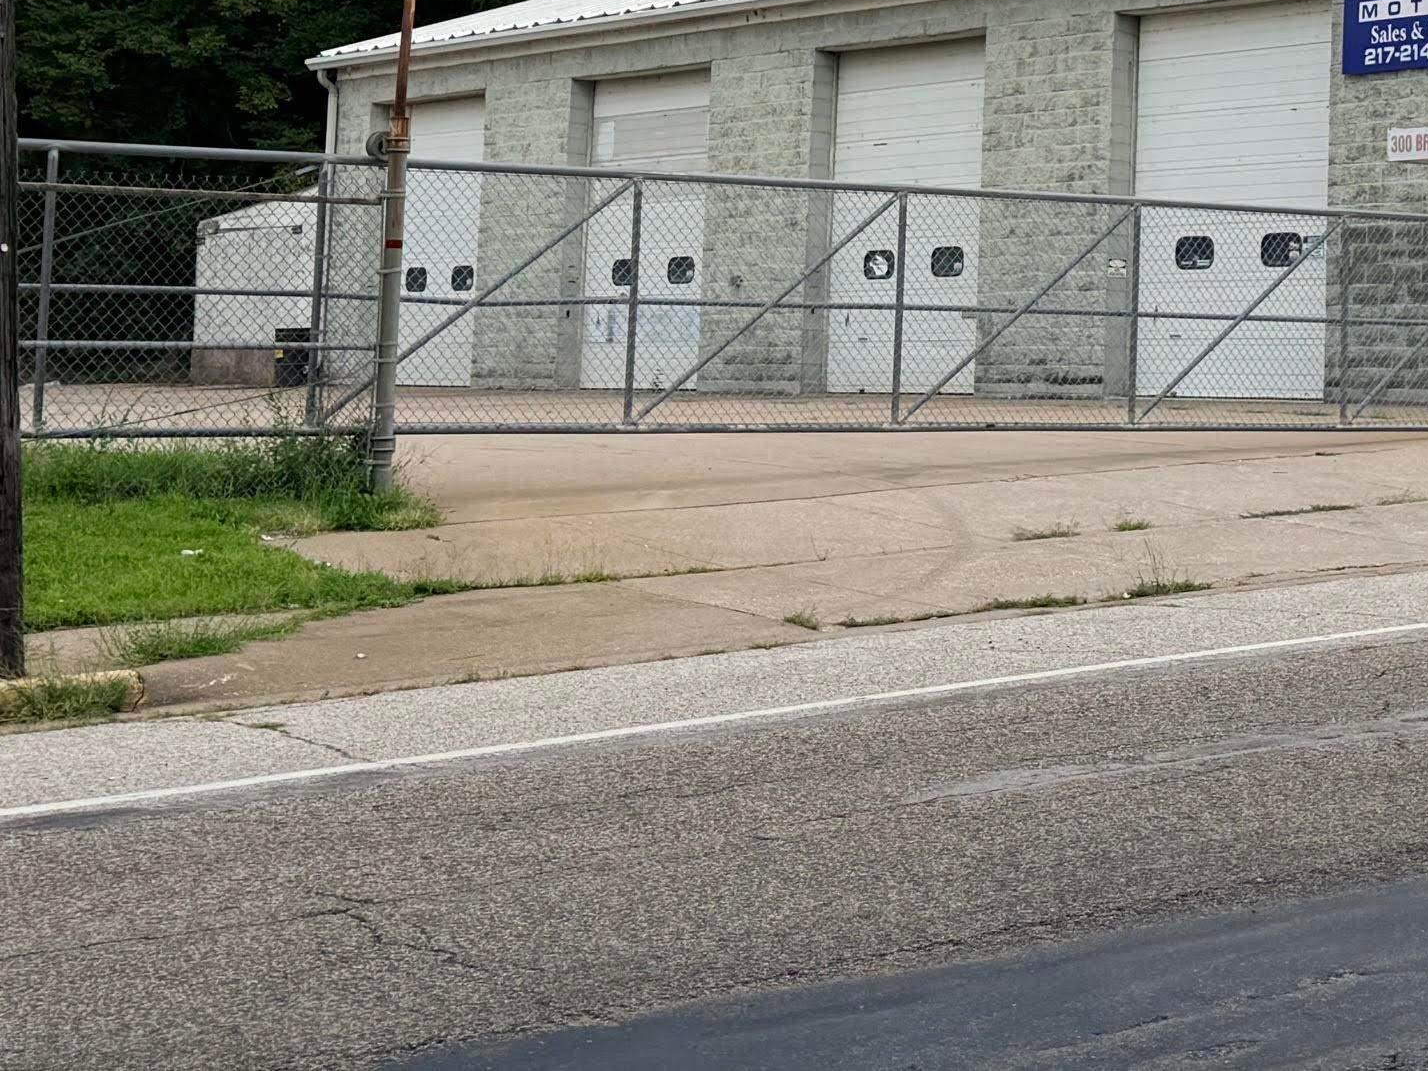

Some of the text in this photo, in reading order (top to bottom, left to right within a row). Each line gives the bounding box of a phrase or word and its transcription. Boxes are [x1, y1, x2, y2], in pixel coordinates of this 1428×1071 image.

[1371, 24, 1407, 44] Sales
[1411, 21, 1424, 40] &
[1391, 135, 1412, 153] 300
